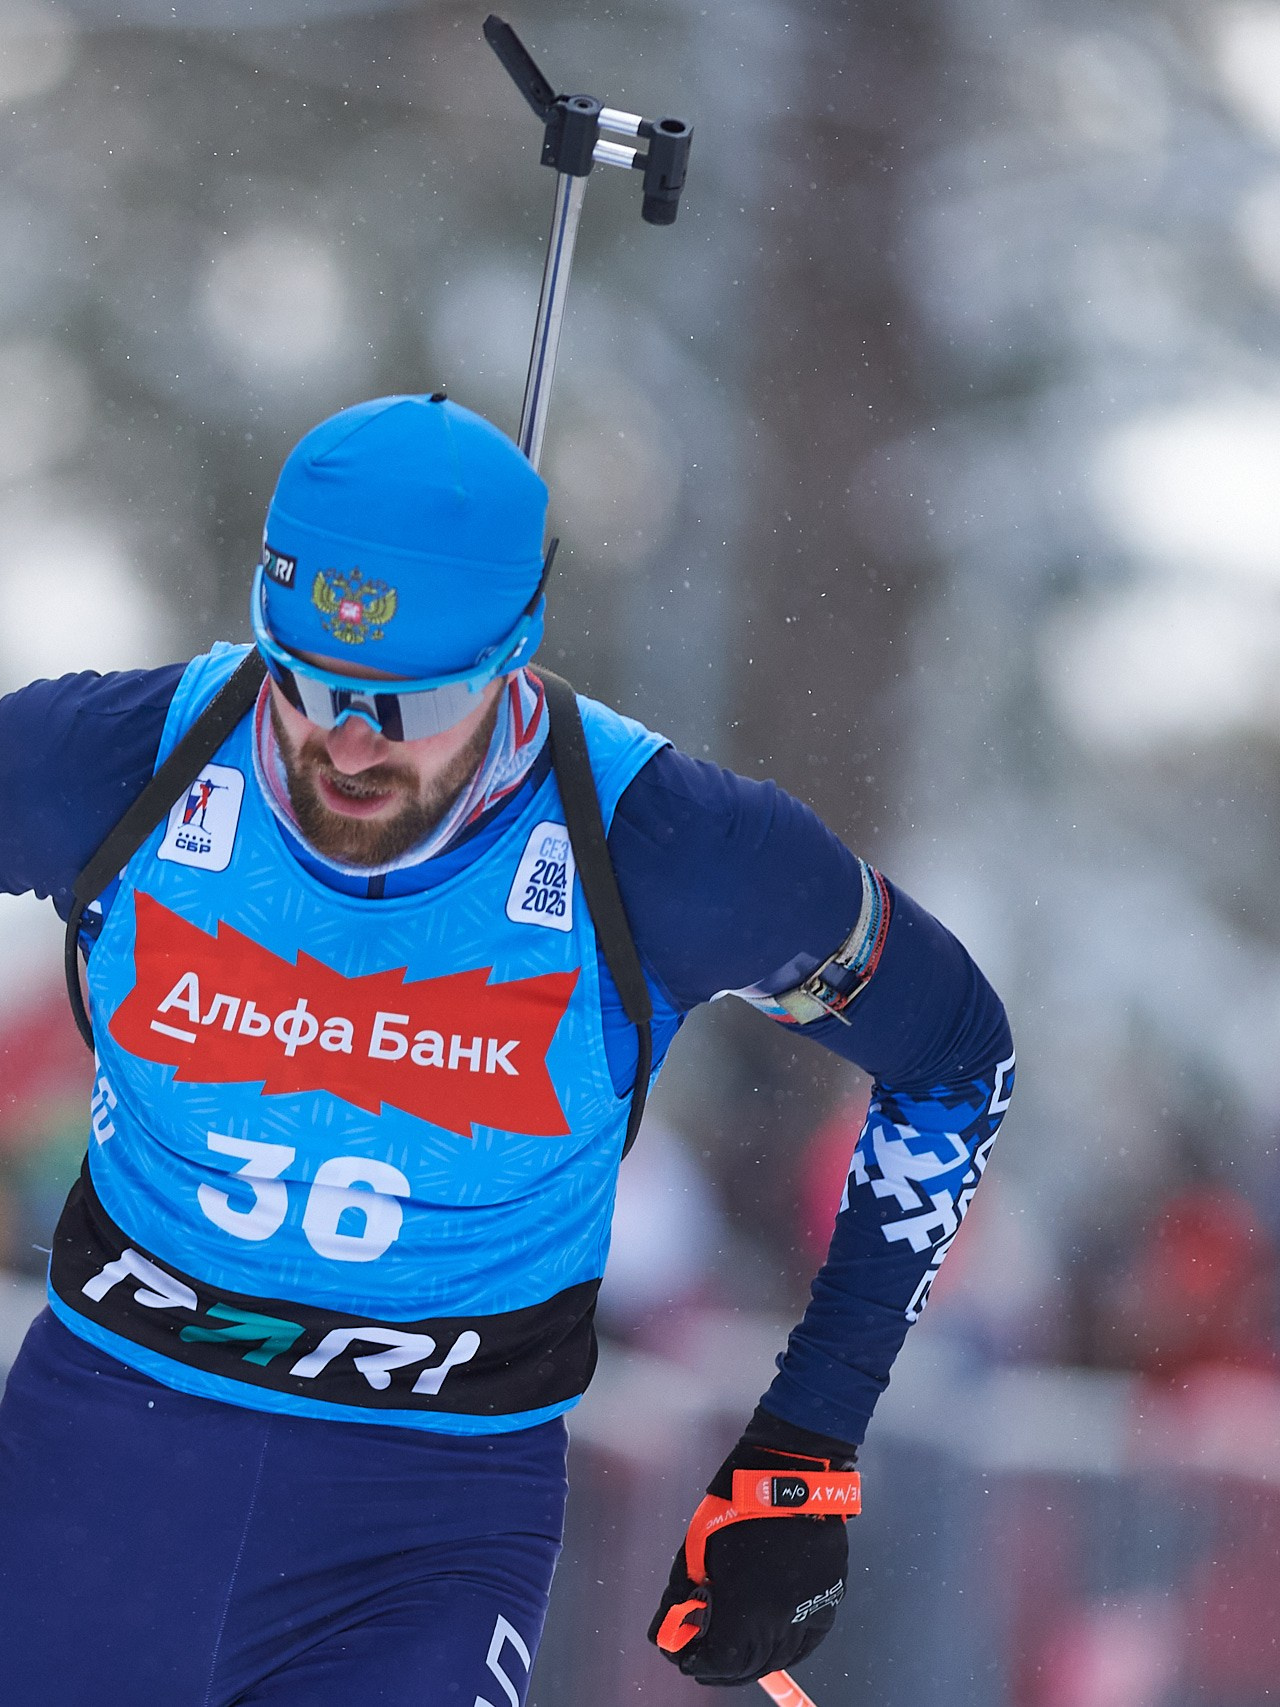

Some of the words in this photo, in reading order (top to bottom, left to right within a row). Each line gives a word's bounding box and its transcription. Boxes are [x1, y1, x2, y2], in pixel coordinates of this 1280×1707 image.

[175, 838, 212, 854] СБР
[539, 836, 569, 862] СЕЗ
[521, 885, 566, 917] 2025
[156, 971, 355, 1057] Альфа
[367, 1010, 521, 1076] Банк
[197, 1131, 411, 1263] 36
[811, 1484, 861, 1505] E/WAY
